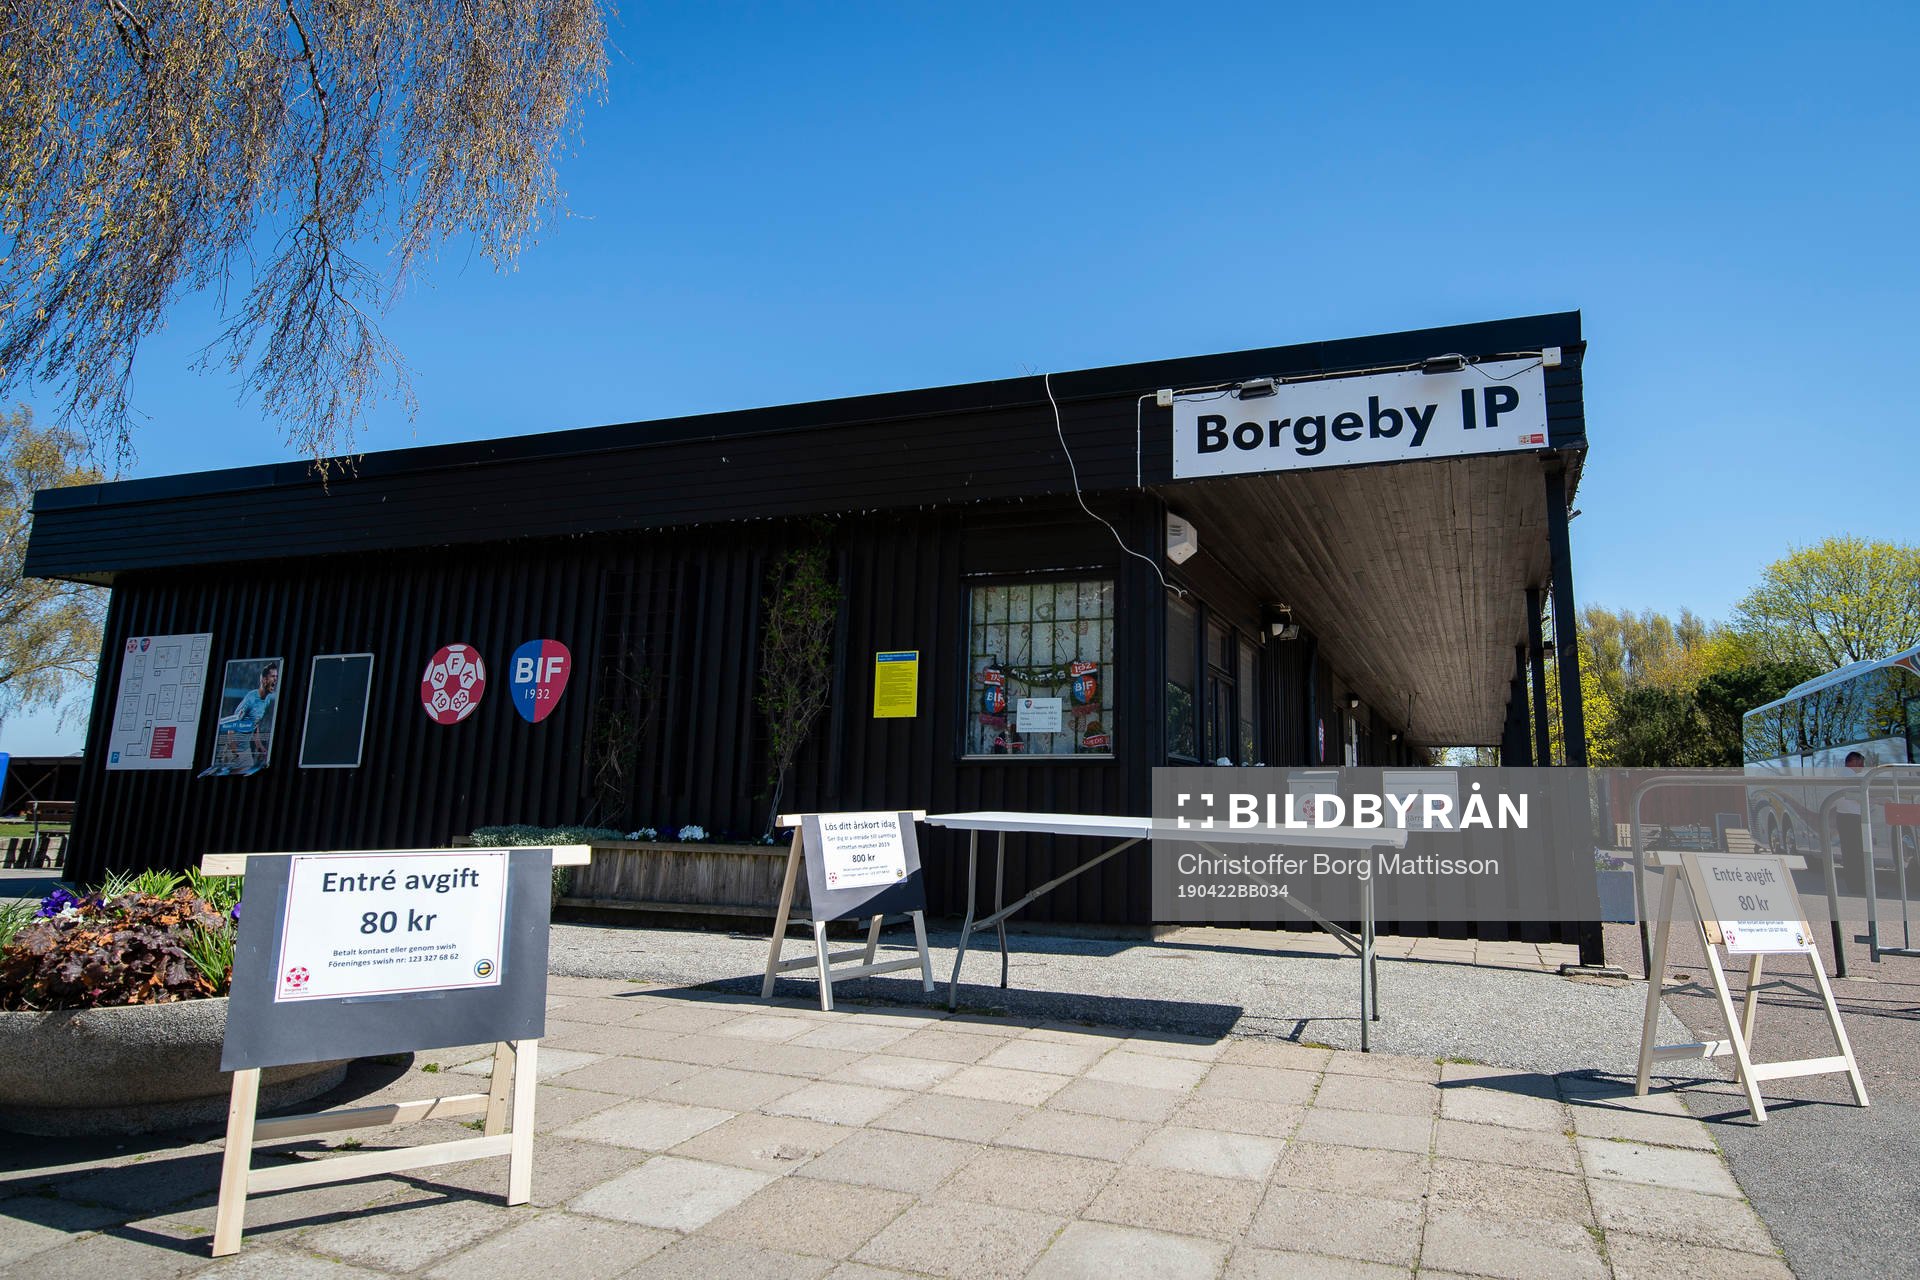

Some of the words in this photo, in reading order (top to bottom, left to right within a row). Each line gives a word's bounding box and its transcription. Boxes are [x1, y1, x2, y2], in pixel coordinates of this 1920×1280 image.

[1197, 396, 1438, 456] Borgeby
[1461, 385, 1521, 431] IP
[515, 657, 564, 684] BIF
[524, 688, 550, 700] 1932
[824, 823, 838, 831] Lös
[839, 822, 852, 830] ditt
[853, 821, 880, 830] årskort
[881, 820, 897, 830] idag
[852, 854, 866, 863] 800
[867, 853, 876, 862] kr
[322, 869, 396, 893] Entré
[405, 867, 480, 894] avgift
[1712, 866, 1743, 883] Entré
[1744, 868, 1775, 886] avgift
[1738, 895, 1755, 911] 80
[1755, 894, 1769, 911] kr
[360, 910, 397, 935] 80
[407, 908, 437, 933] kr
[333, 949, 357, 957] Betalt
[358, 947, 389, 956] kontant
[390, 946, 407, 954] eller
[408, 945, 435, 954] genom
[436, 943, 457, 951] swish
[328, 959, 371, 968] Föreninges
[372, 956, 394, 965] swish
[395, 956, 407, 964] nr:
[408, 955, 422, 963] 123
[423, 954, 438, 963] 327
[438, 953, 449, 961] 68
[449, 952, 459, 960] 62
